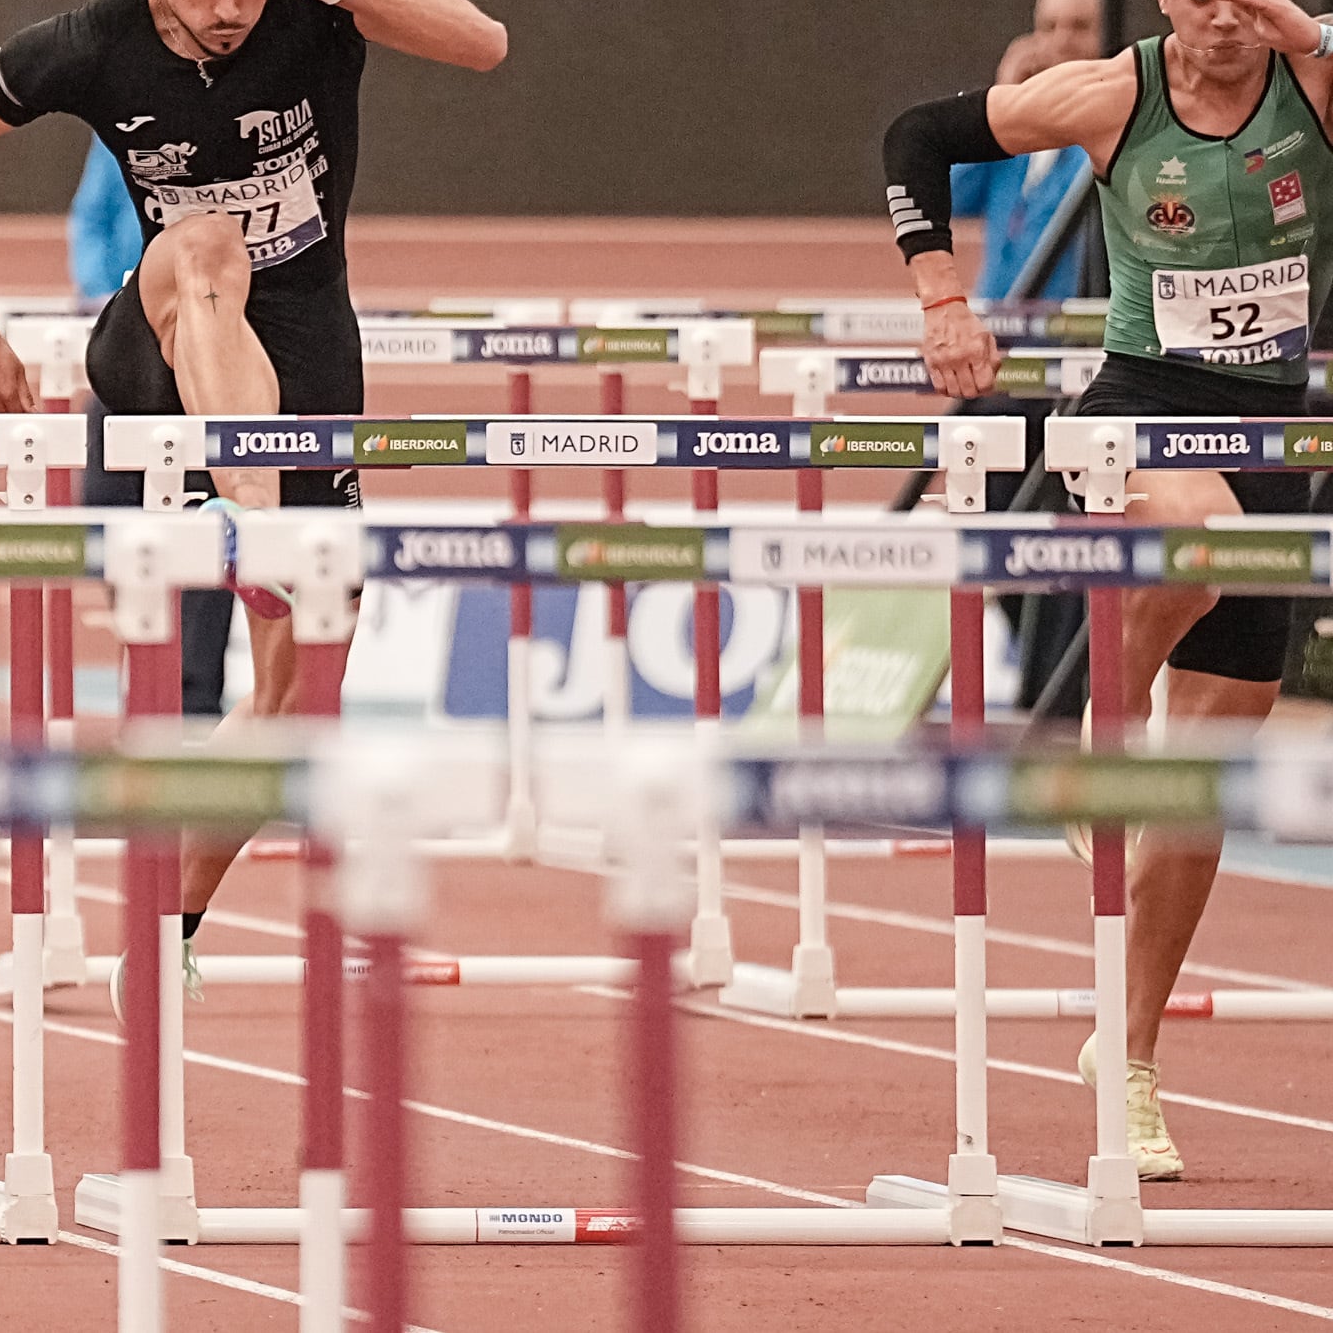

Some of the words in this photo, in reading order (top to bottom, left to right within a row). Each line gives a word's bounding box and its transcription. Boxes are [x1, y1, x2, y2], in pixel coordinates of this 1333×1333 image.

[195, 164, 305, 204] MADRID
[206, 202, 281, 238] 77
[1195, 262, 1306, 297] MADRID
[1209, 302, 1264, 341] 52
[233, 430, 320, 456] Joma
[389, 438, 459, 451] IBERDROLA
[541, 434, 639, 453] MADRID
[693, 431, 781, 456] Joma
[846, 440, 916, 452] IBERDROLA
[1162, 432, 1251, 458] Joma
[502, 1213, 564, 1223] MONDO
